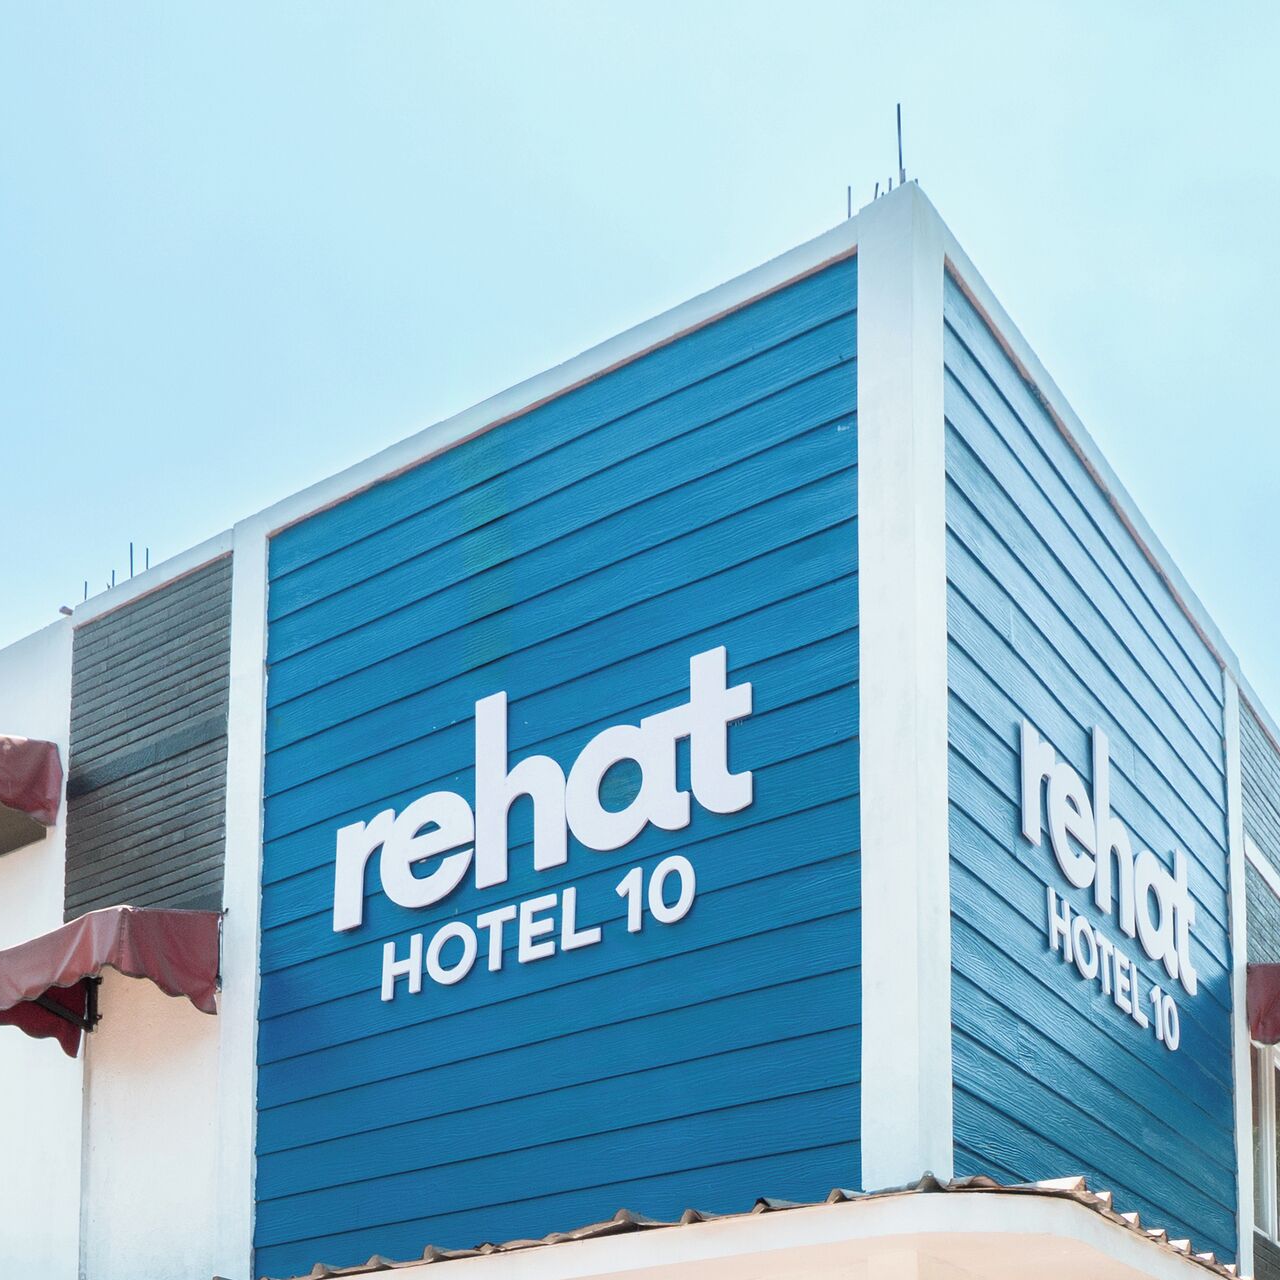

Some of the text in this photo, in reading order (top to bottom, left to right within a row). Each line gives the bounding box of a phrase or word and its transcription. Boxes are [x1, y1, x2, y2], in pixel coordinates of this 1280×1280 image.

[332, 645, 753, 932] rehat
[1020, 721, 1197, 996] rehat
[380, 855, 696, 1001] HOTEL 10
[1046, 885, 1180, 1051] HOTEL 10
